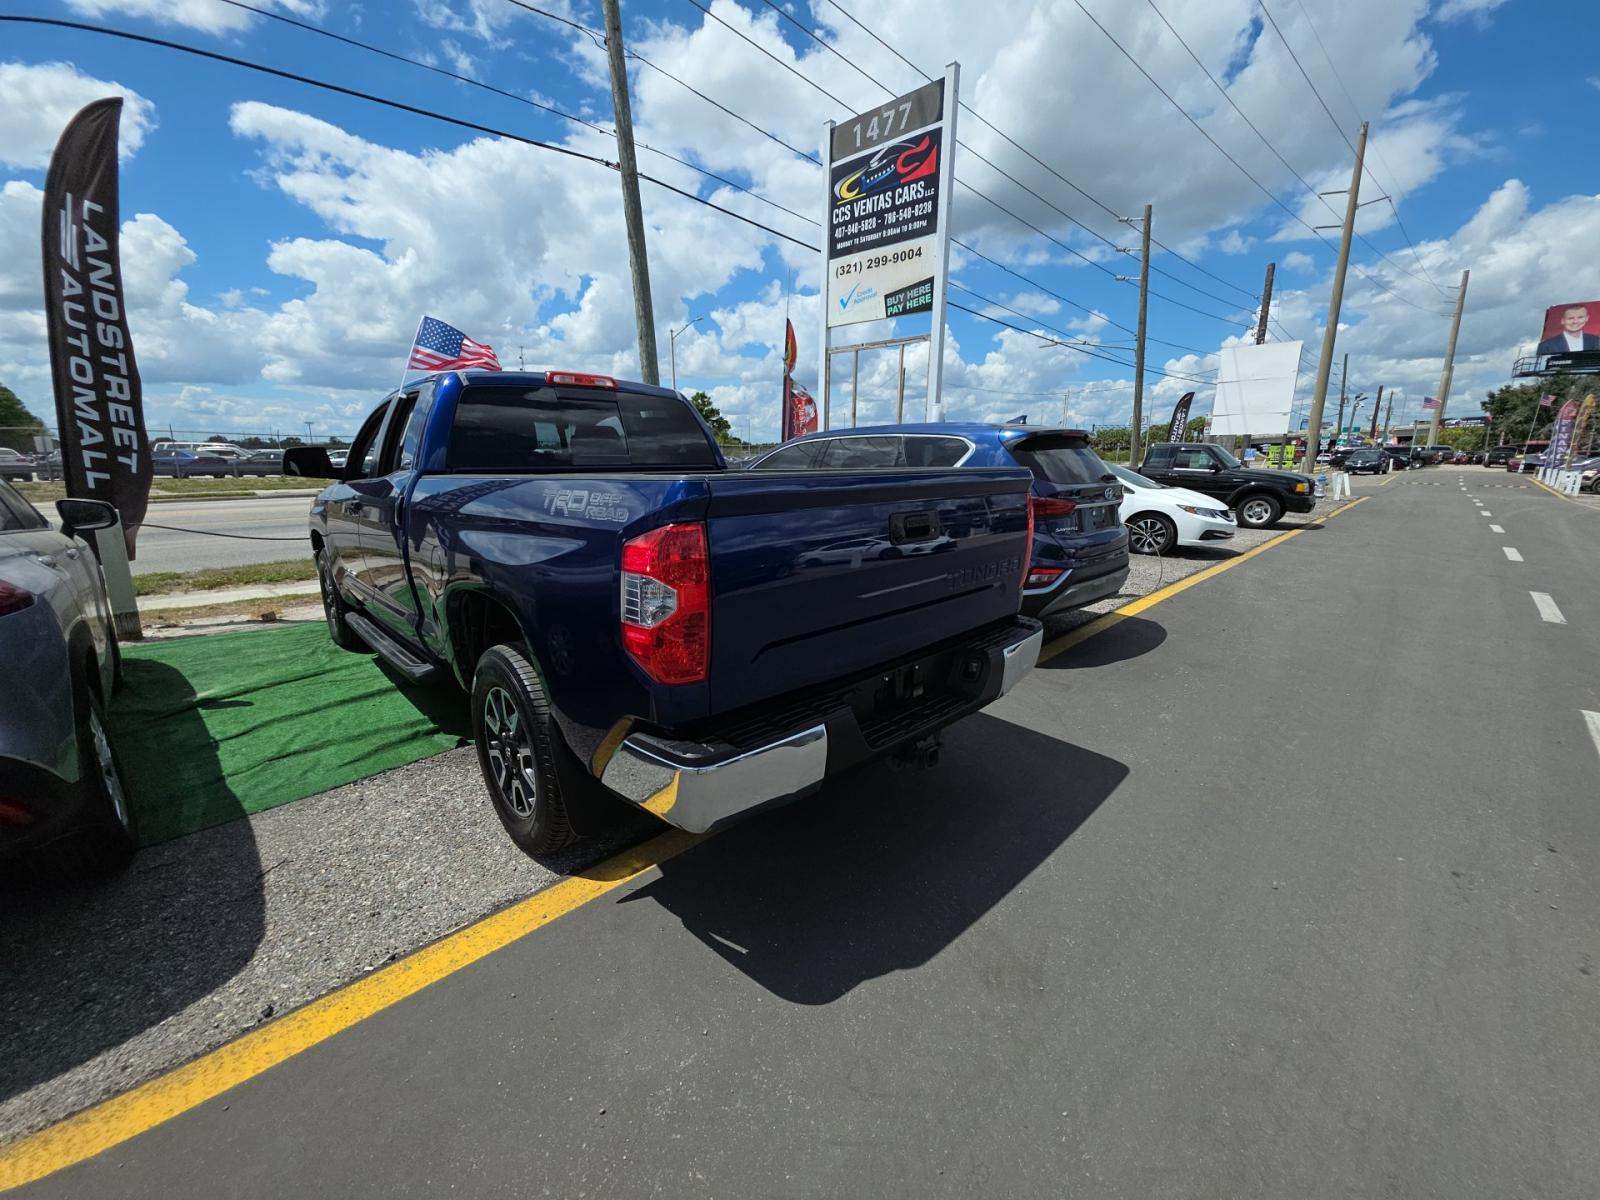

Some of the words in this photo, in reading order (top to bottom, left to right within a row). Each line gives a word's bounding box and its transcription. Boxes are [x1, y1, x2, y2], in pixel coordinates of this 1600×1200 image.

[853, 101, 912, 148] 1477
[833, 205, 851, 224] CCS
[854, 191, 892, 218] VENTAS
[895, 181, 925, 205] CARS
[925, 188, 935, 197] LLC
[859, 231, 882, 244] SATURDAY
[835, 261, 862, 279] (321)
[866, 246, 922, 270] 299-9004
[886, 294, 906, 307] BUY
[907, 283, 931, 298] HERE
[887, 303, 906, 316] PAY
[906, 295, 932, 309] HERE
[83, 200, 139, 474] LANDSTREET
[61, 268, 111, 489] AUTOMALL
[543, 488, 589, 517] TRD
[585, 505, 629, 522] ROAD
